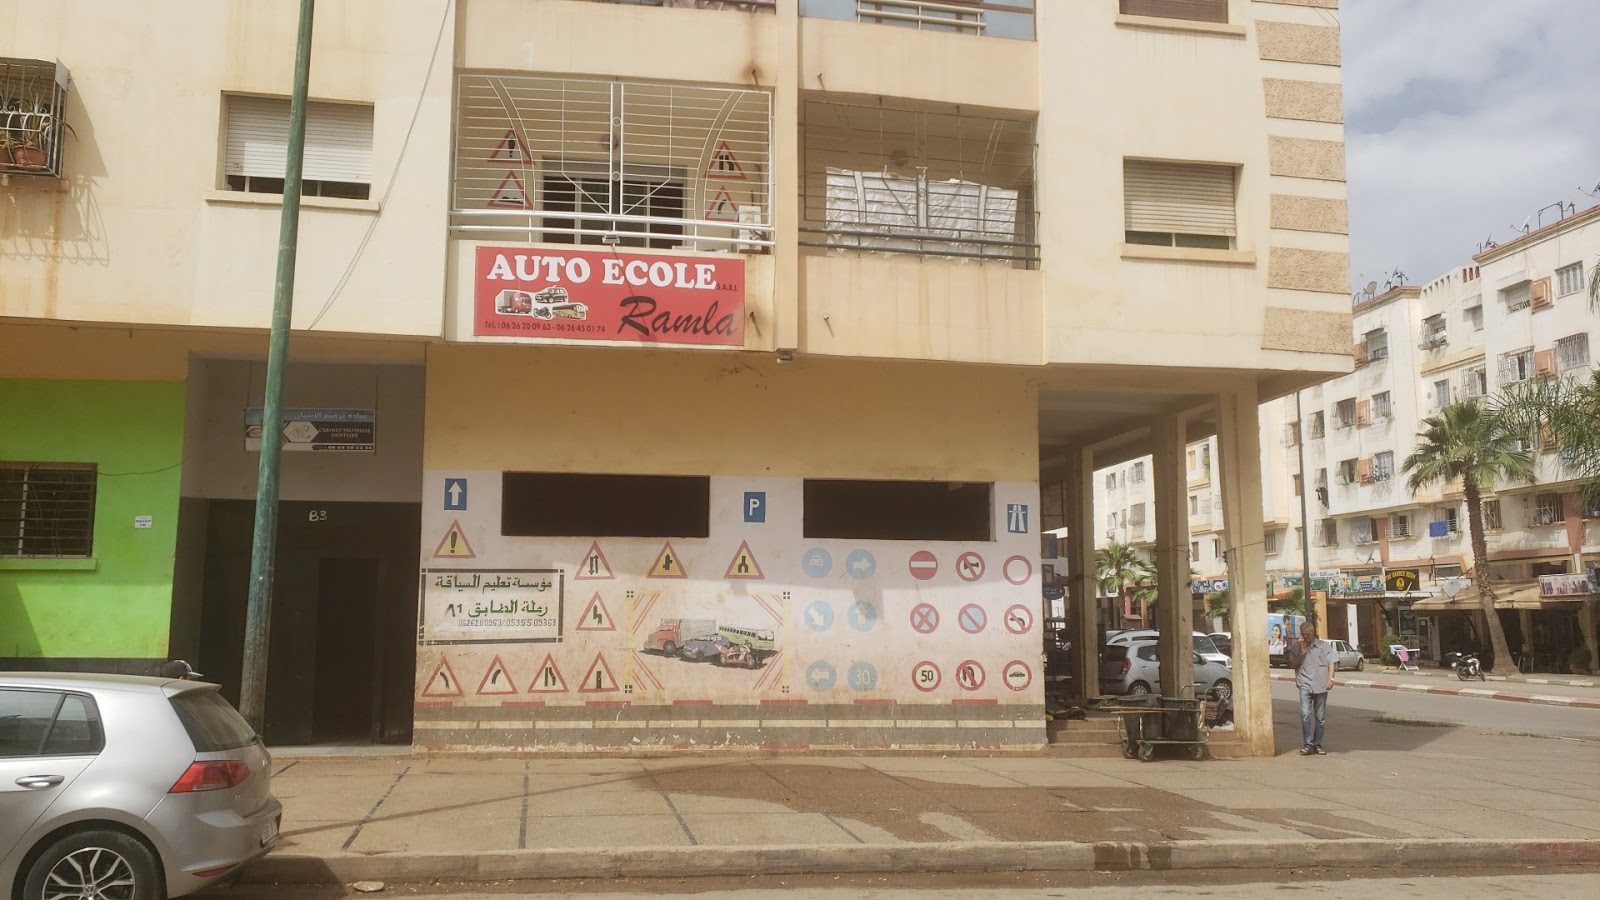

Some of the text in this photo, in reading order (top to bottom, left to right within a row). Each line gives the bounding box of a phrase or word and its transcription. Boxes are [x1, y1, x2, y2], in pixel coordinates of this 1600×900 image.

[486, 253, 717, 290] AUTO ECOLE
[617, 295, 736, 337] Ramla
[501, 322, 510, 330] 06
[512, 322, 520, 330] 26
[522, 323, 531, 331] 20
[532, 323, 541, 331] 09
[542, 323, 551, 331] 63
[556, 323, 565, 331] 06
[567, 324, 575, 332] 26
[586, 325, 595, 333] 01
[309, 510, 328, 521] B3
[749, 498, 760, 516] P
[434, 573, 552, 594] مؤسسة تعليم السياقة
[920, 669, 934, 683] 50
